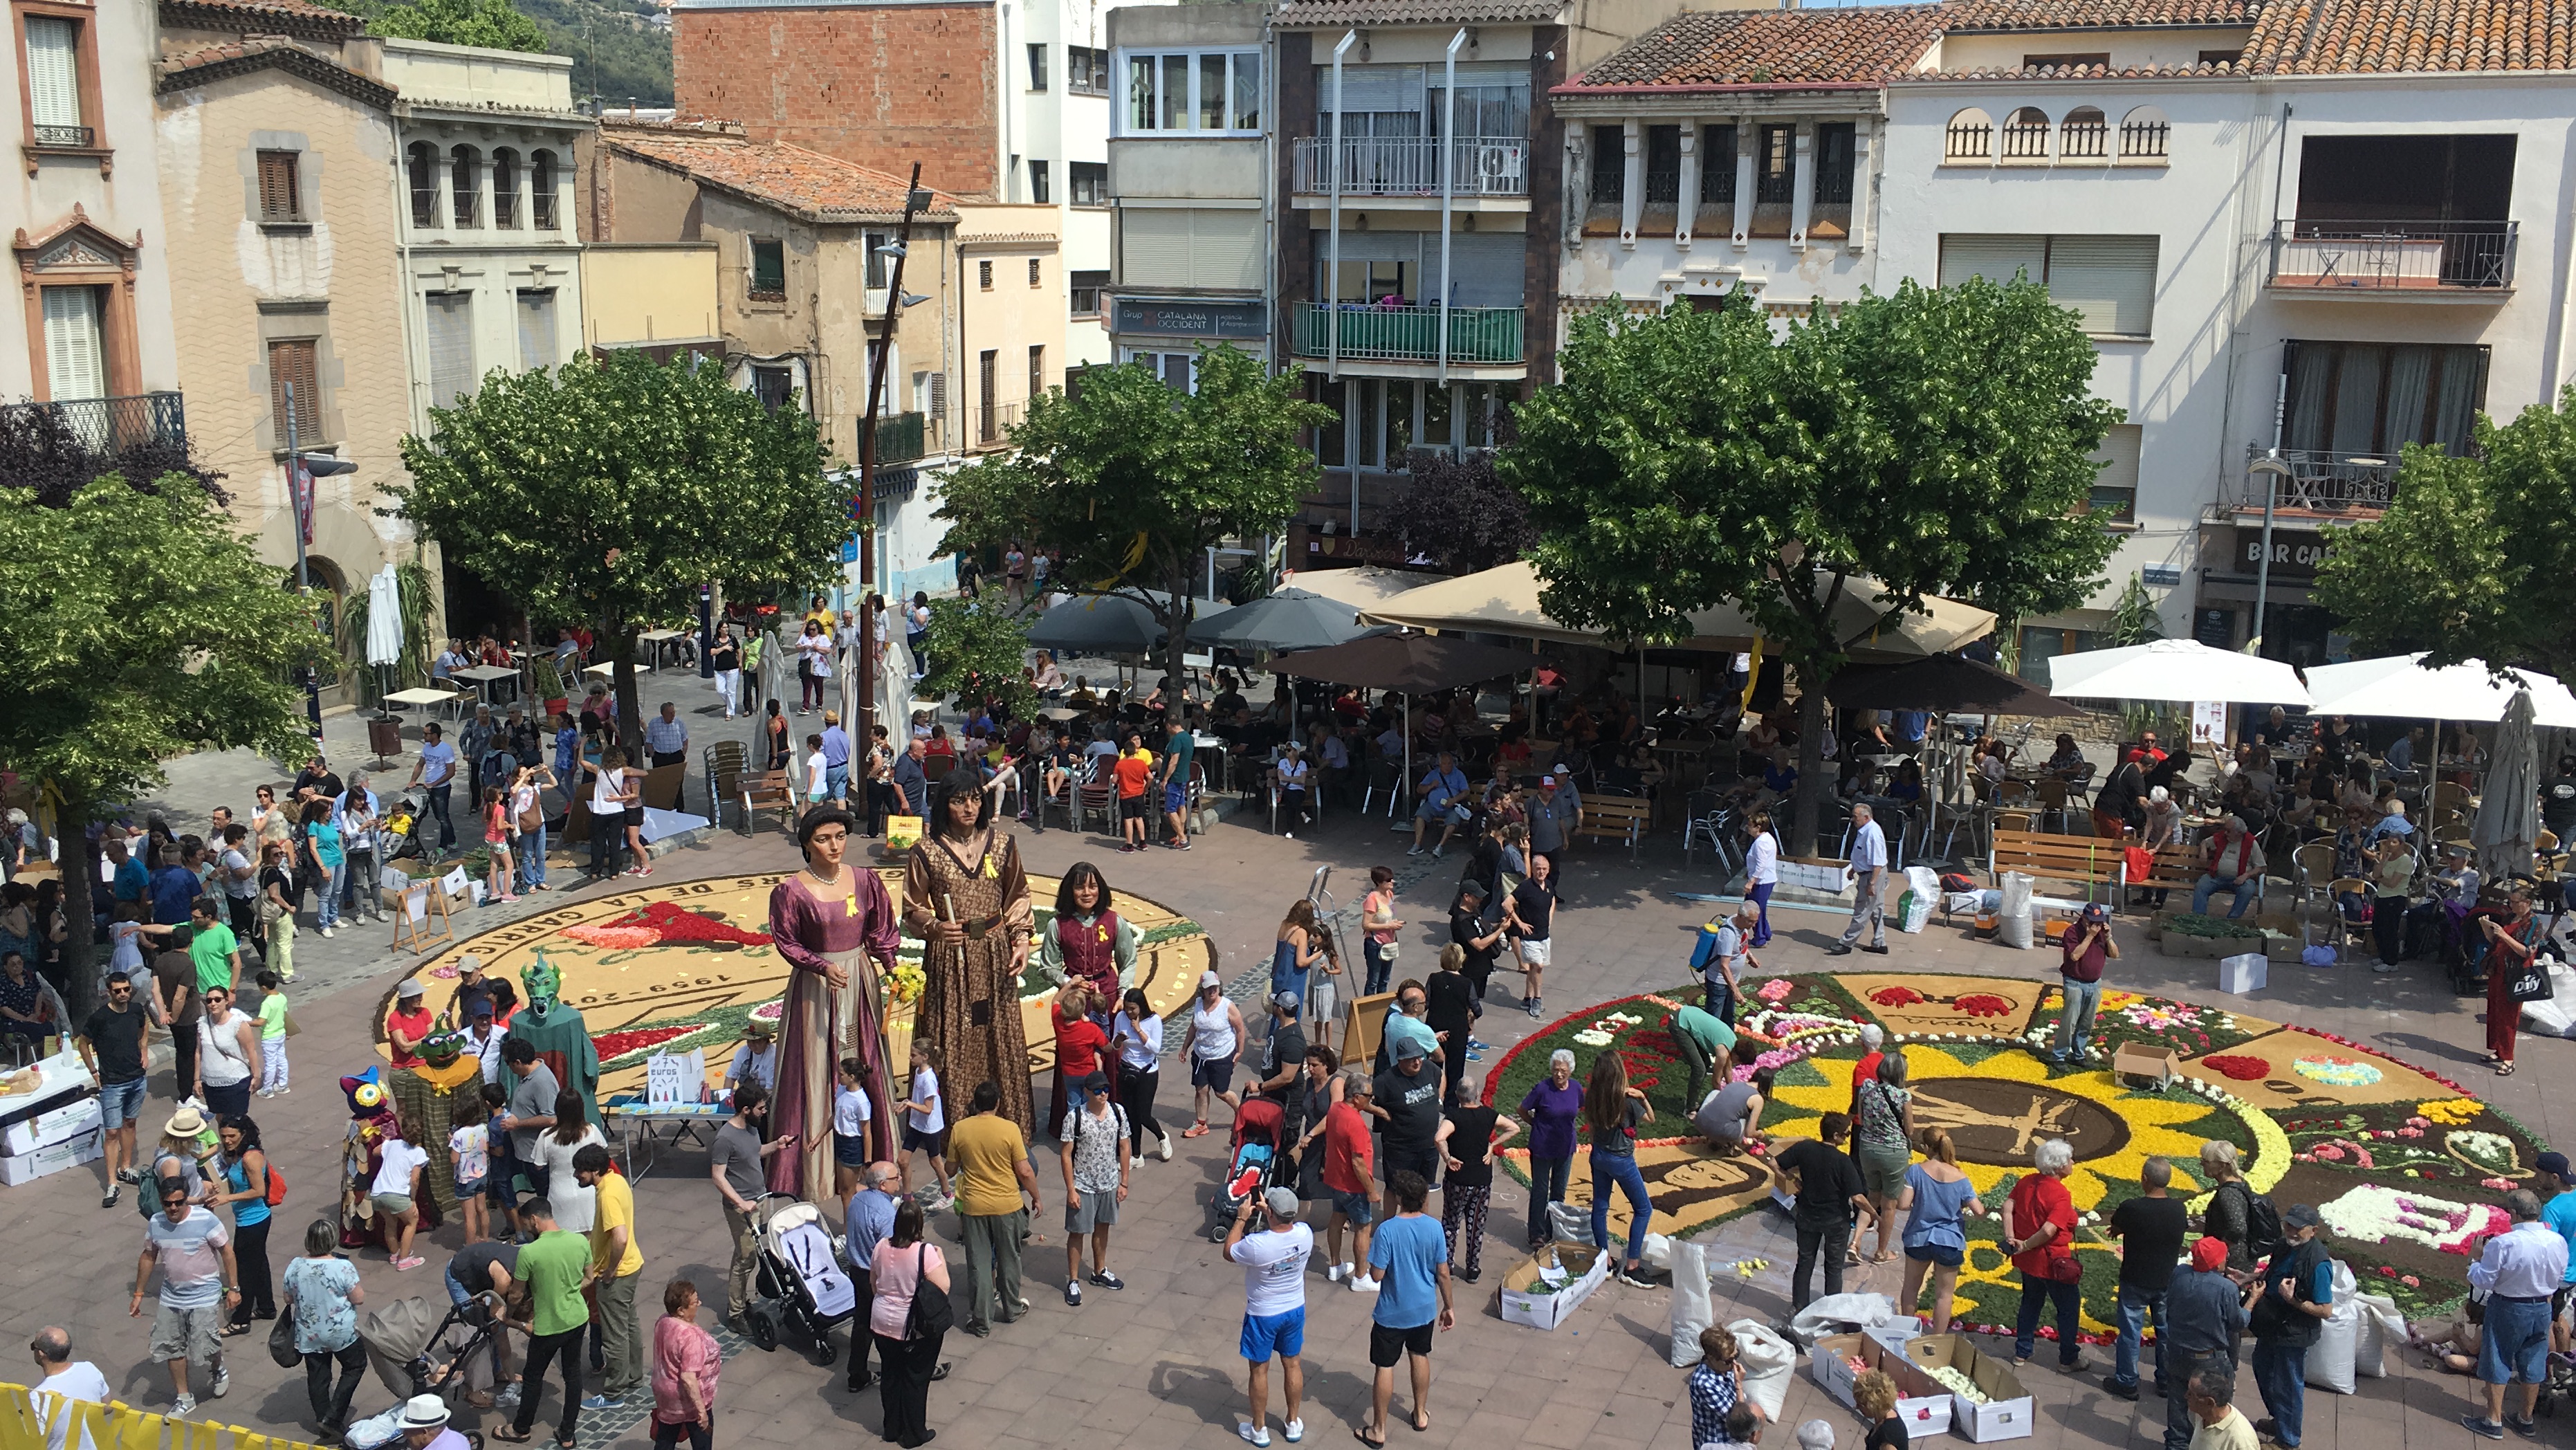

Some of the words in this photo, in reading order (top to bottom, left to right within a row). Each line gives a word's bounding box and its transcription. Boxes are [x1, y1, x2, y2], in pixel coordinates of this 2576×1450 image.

[1123, 309, 1143, 320] Grup
[1157, 311, 1207, 321] CATALANA
[1157, 320, 1207, 329] OCCIDENT
[666, 883, 714, 897] DE
[600, 894, 651, 907] LA
[662, 1057, 669, 1068] 7
